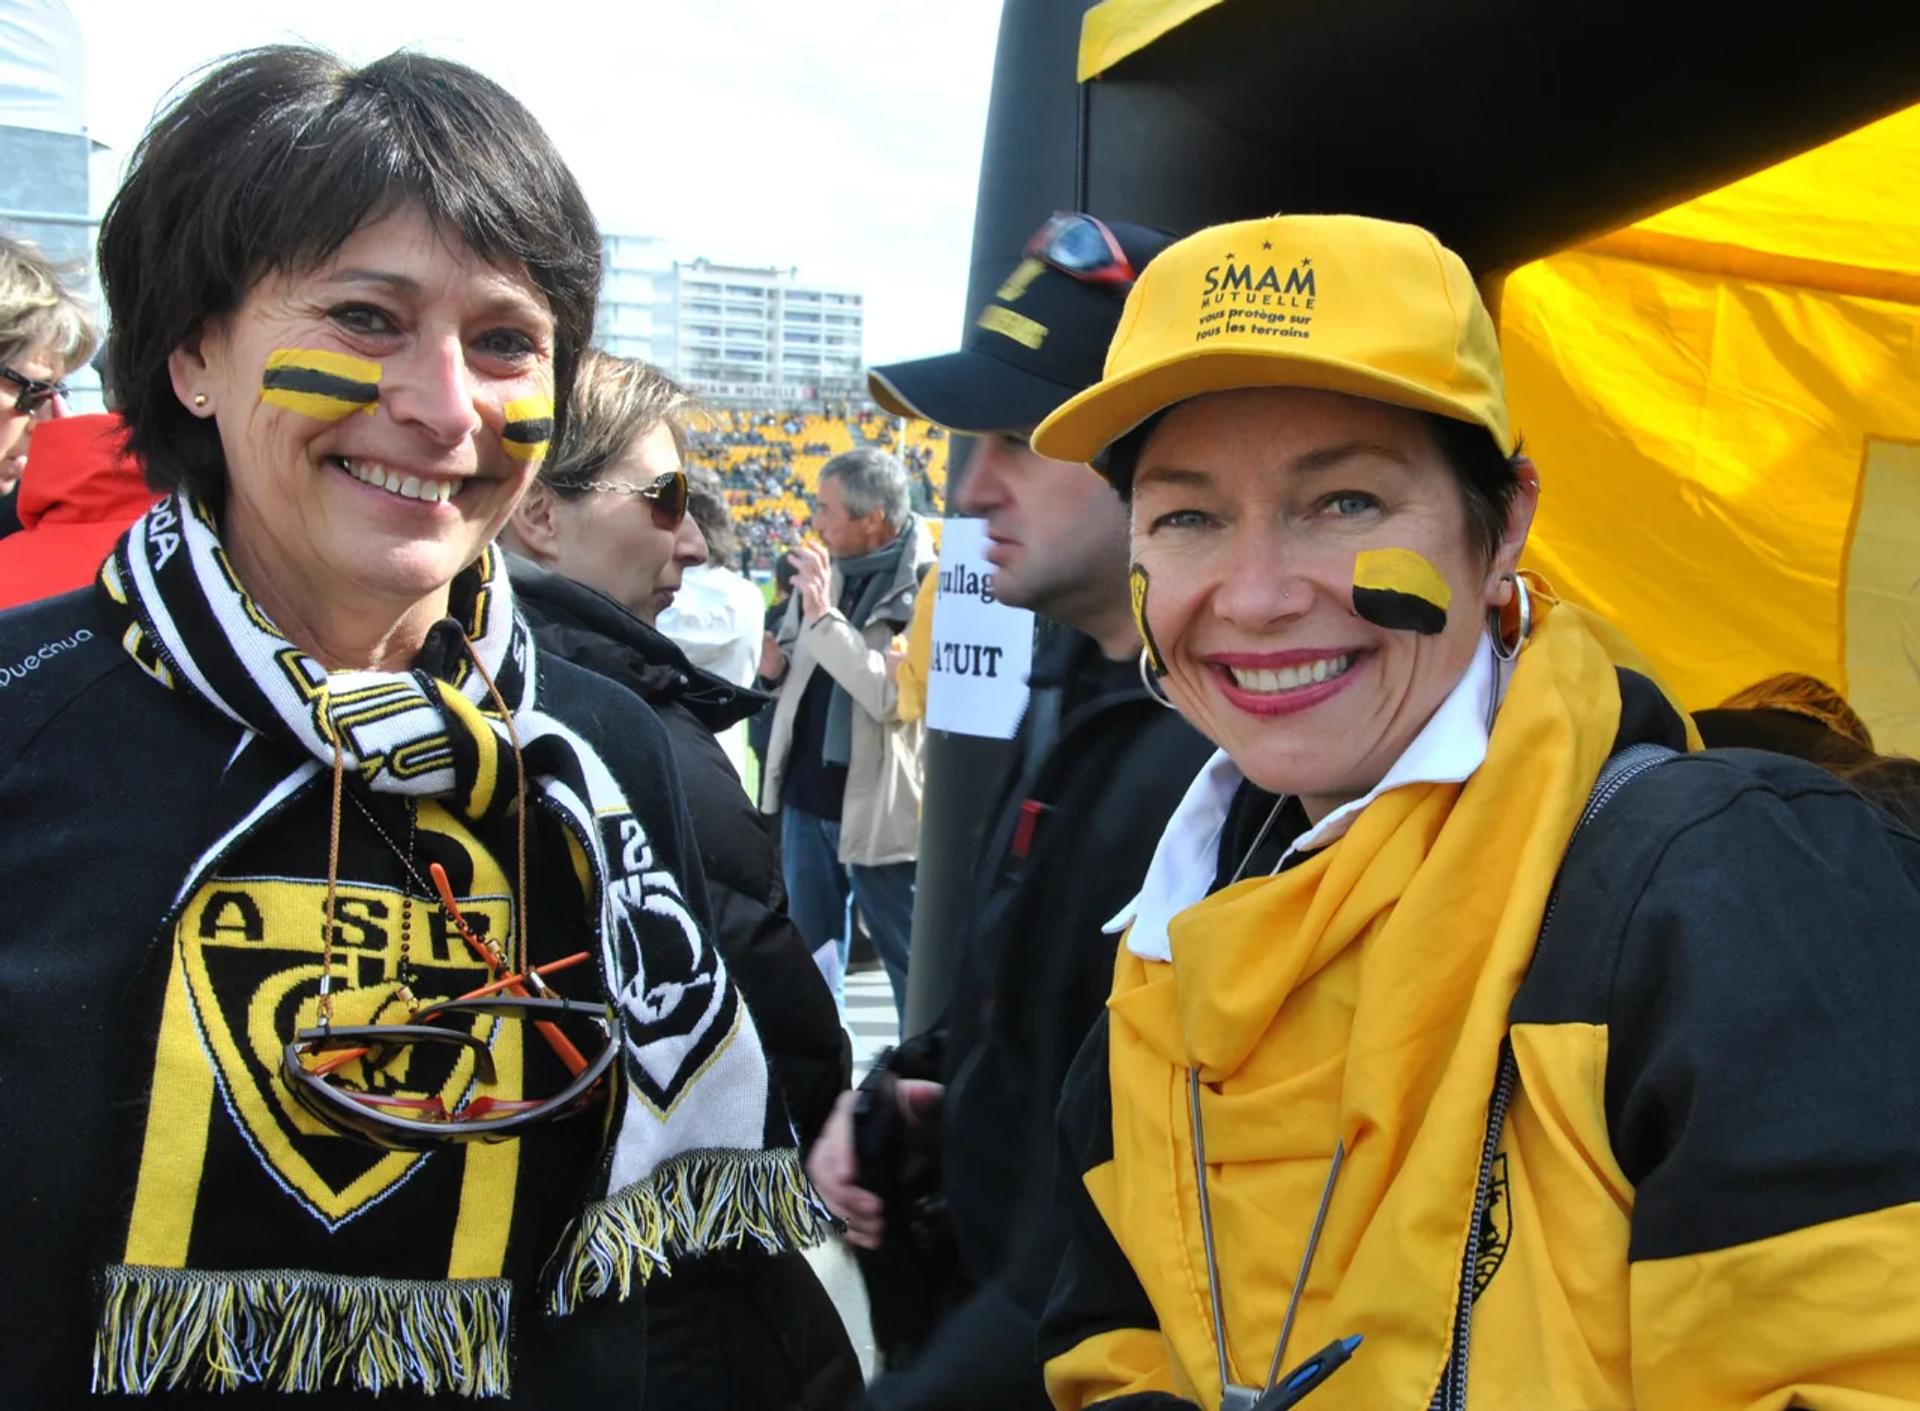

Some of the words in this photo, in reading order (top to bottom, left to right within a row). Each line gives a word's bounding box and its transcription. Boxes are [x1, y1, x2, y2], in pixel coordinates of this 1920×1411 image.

[1203, 263, 1316, 297] SMAM
[1201, 291, 1315, 310] MUTUELLE
[1199, 309, 1225, 325] vous
[1228, 308, 1286, 324] protège
[1289, 314, 1312, 325] sur
[1225, 320, 1246, 333] les
[1250, 323, 1310, 339] terrains
